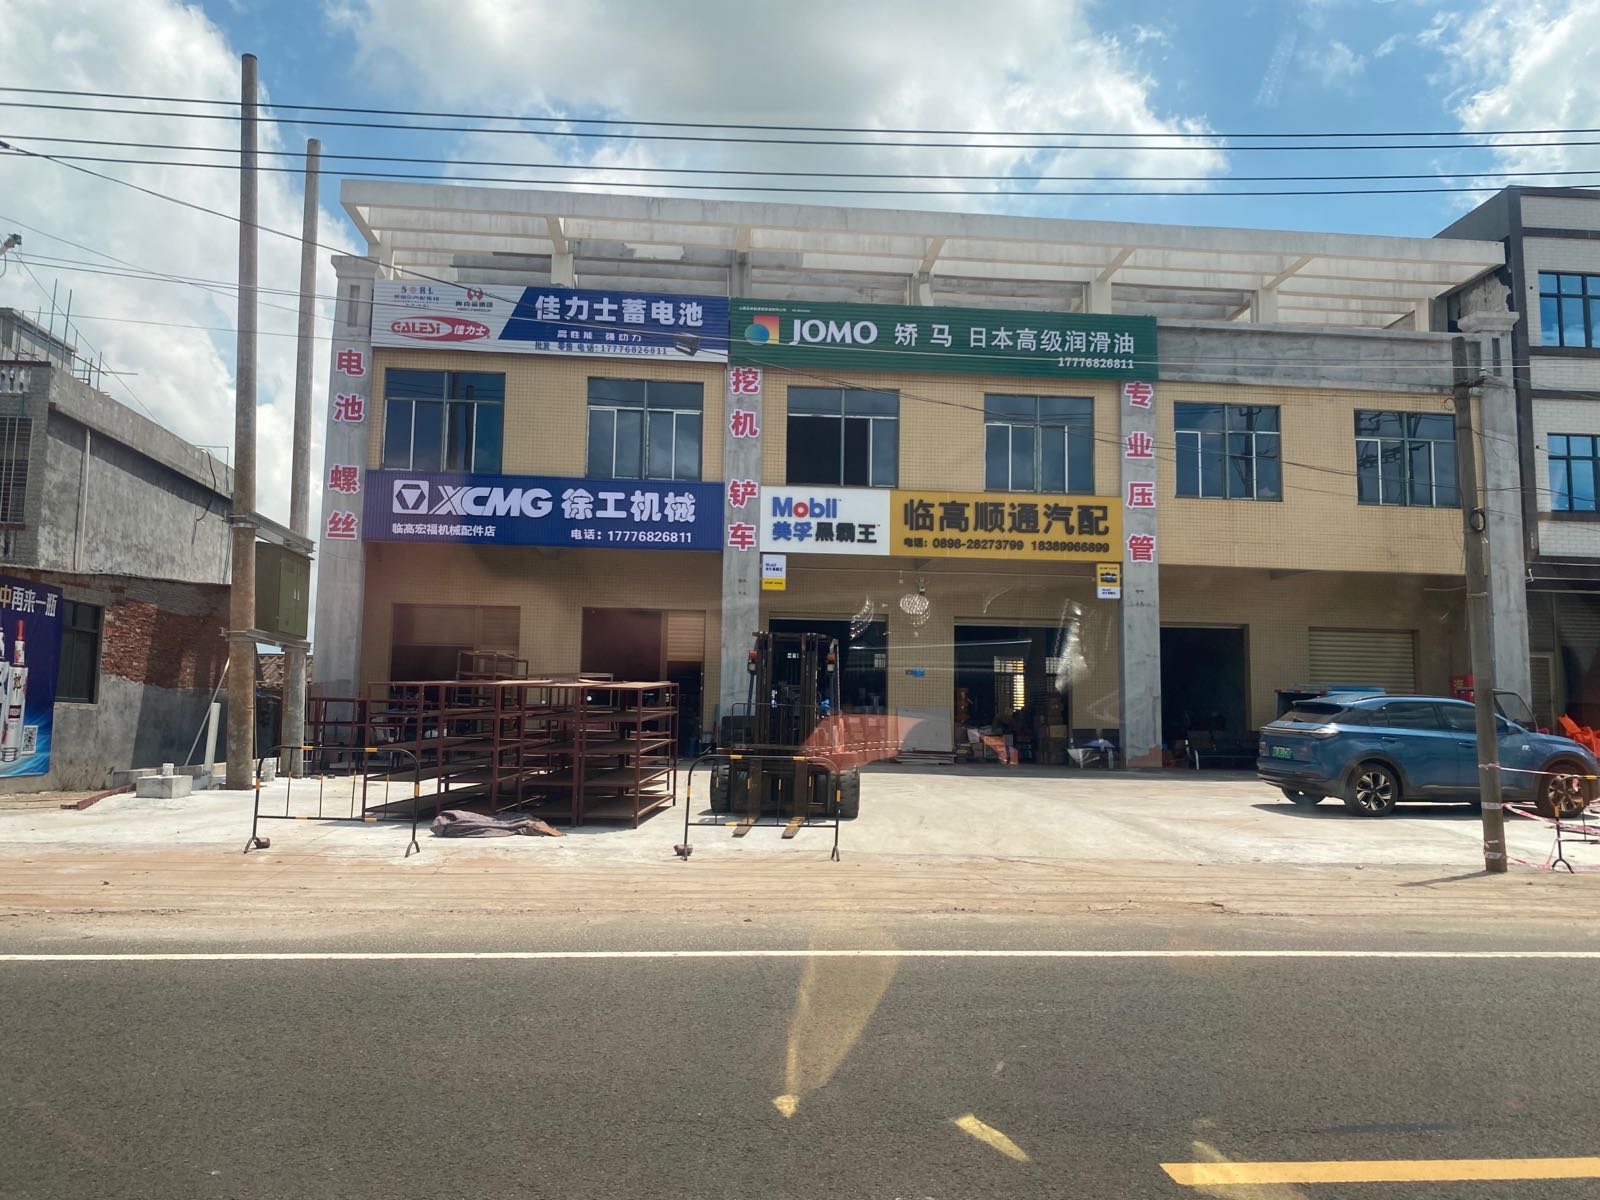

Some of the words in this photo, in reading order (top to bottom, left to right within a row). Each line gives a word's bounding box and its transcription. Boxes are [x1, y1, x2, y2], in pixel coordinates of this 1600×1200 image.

[534, 295, 704, 327] 佳力士蓄电池
[788, 319, 878, 346] JOMO
[969, 327, 1135, 355] 日本高级润滑油
[1057, 357, 1135, 369] 17776826811
[429, 485, 553, 518] XCMG
[562, 488, 697, 523] 徐工机械
[772, 496, 838, 518] Mobil
[903, 499, 1111, 537] 临高顺通汽配
[391, 523, 497, 537] 临高宏福机械配件店
